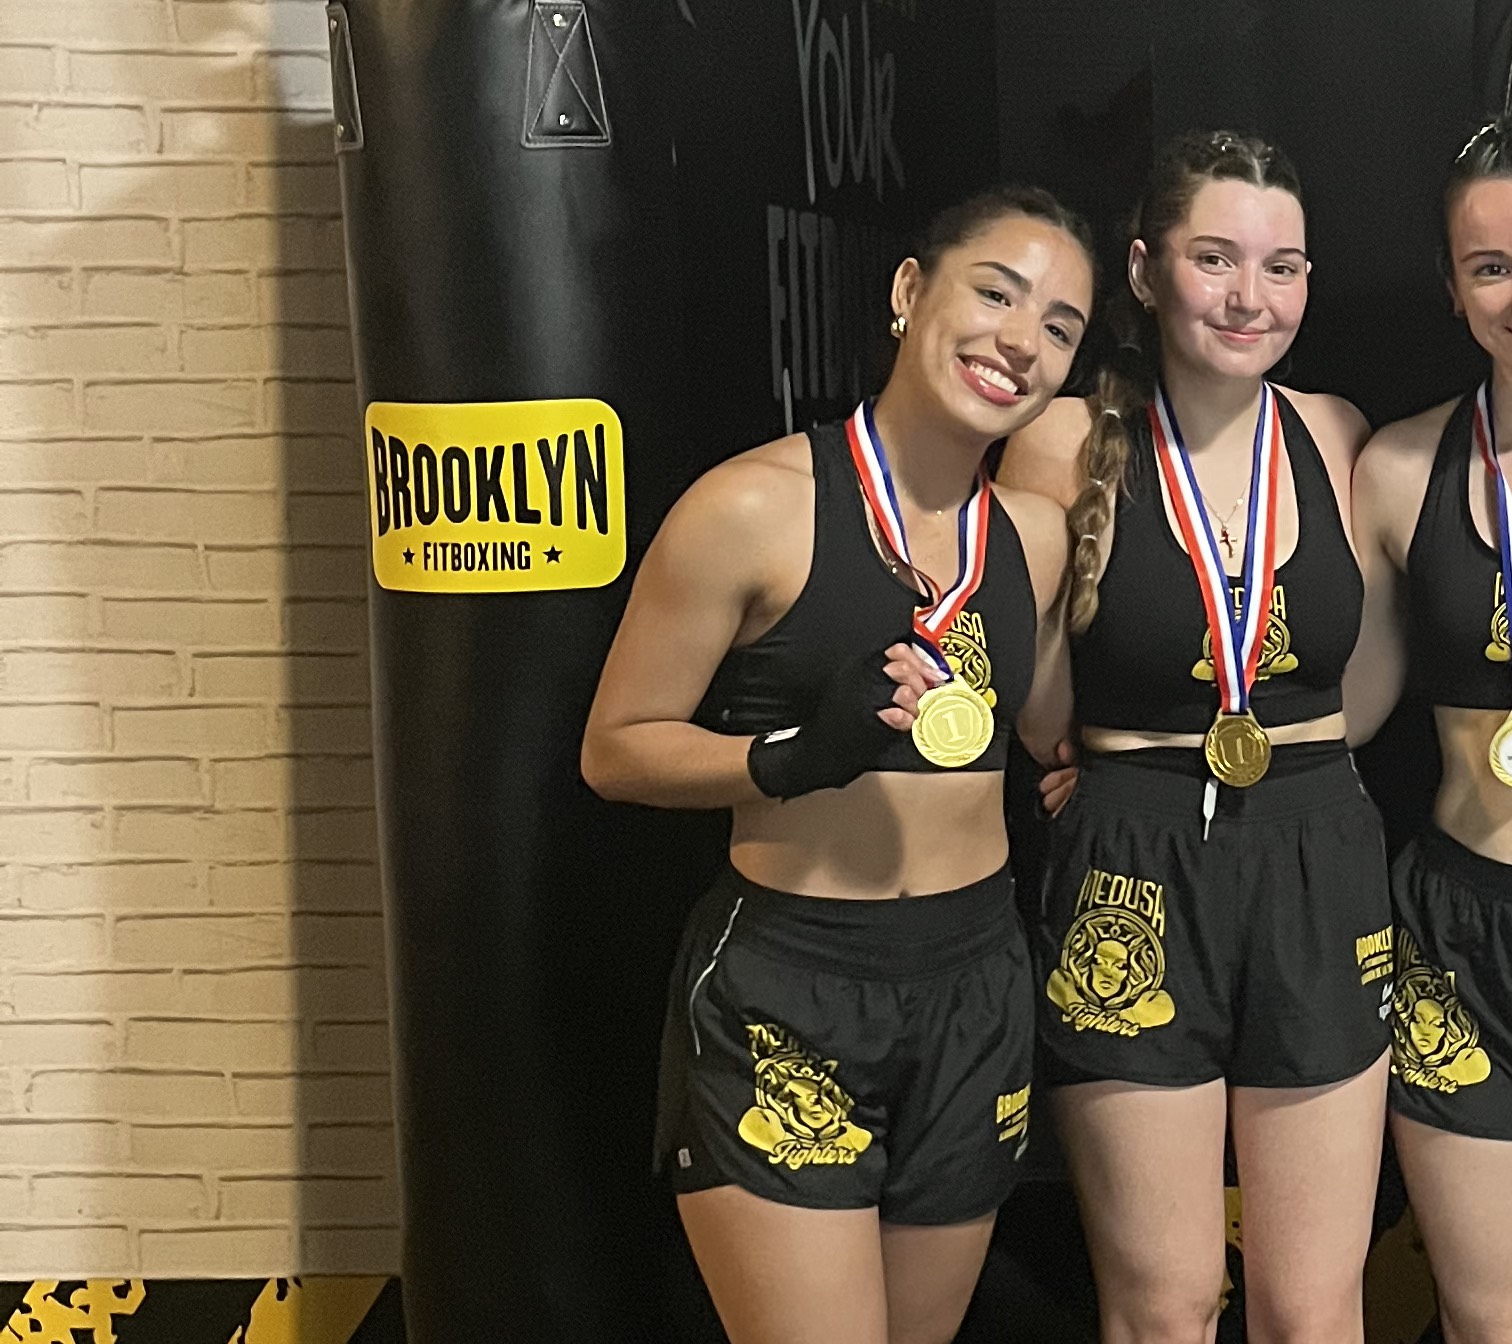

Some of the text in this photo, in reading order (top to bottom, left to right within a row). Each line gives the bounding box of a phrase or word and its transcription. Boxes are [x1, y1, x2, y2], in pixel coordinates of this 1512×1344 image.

[371, 423, 609, 537] BROOKLYN
[423, 541, 532, 573] FITBOXING
[1073, 866, 1166, 937] MEDUSA
[768, 1140, 857, 1170] Fighters
